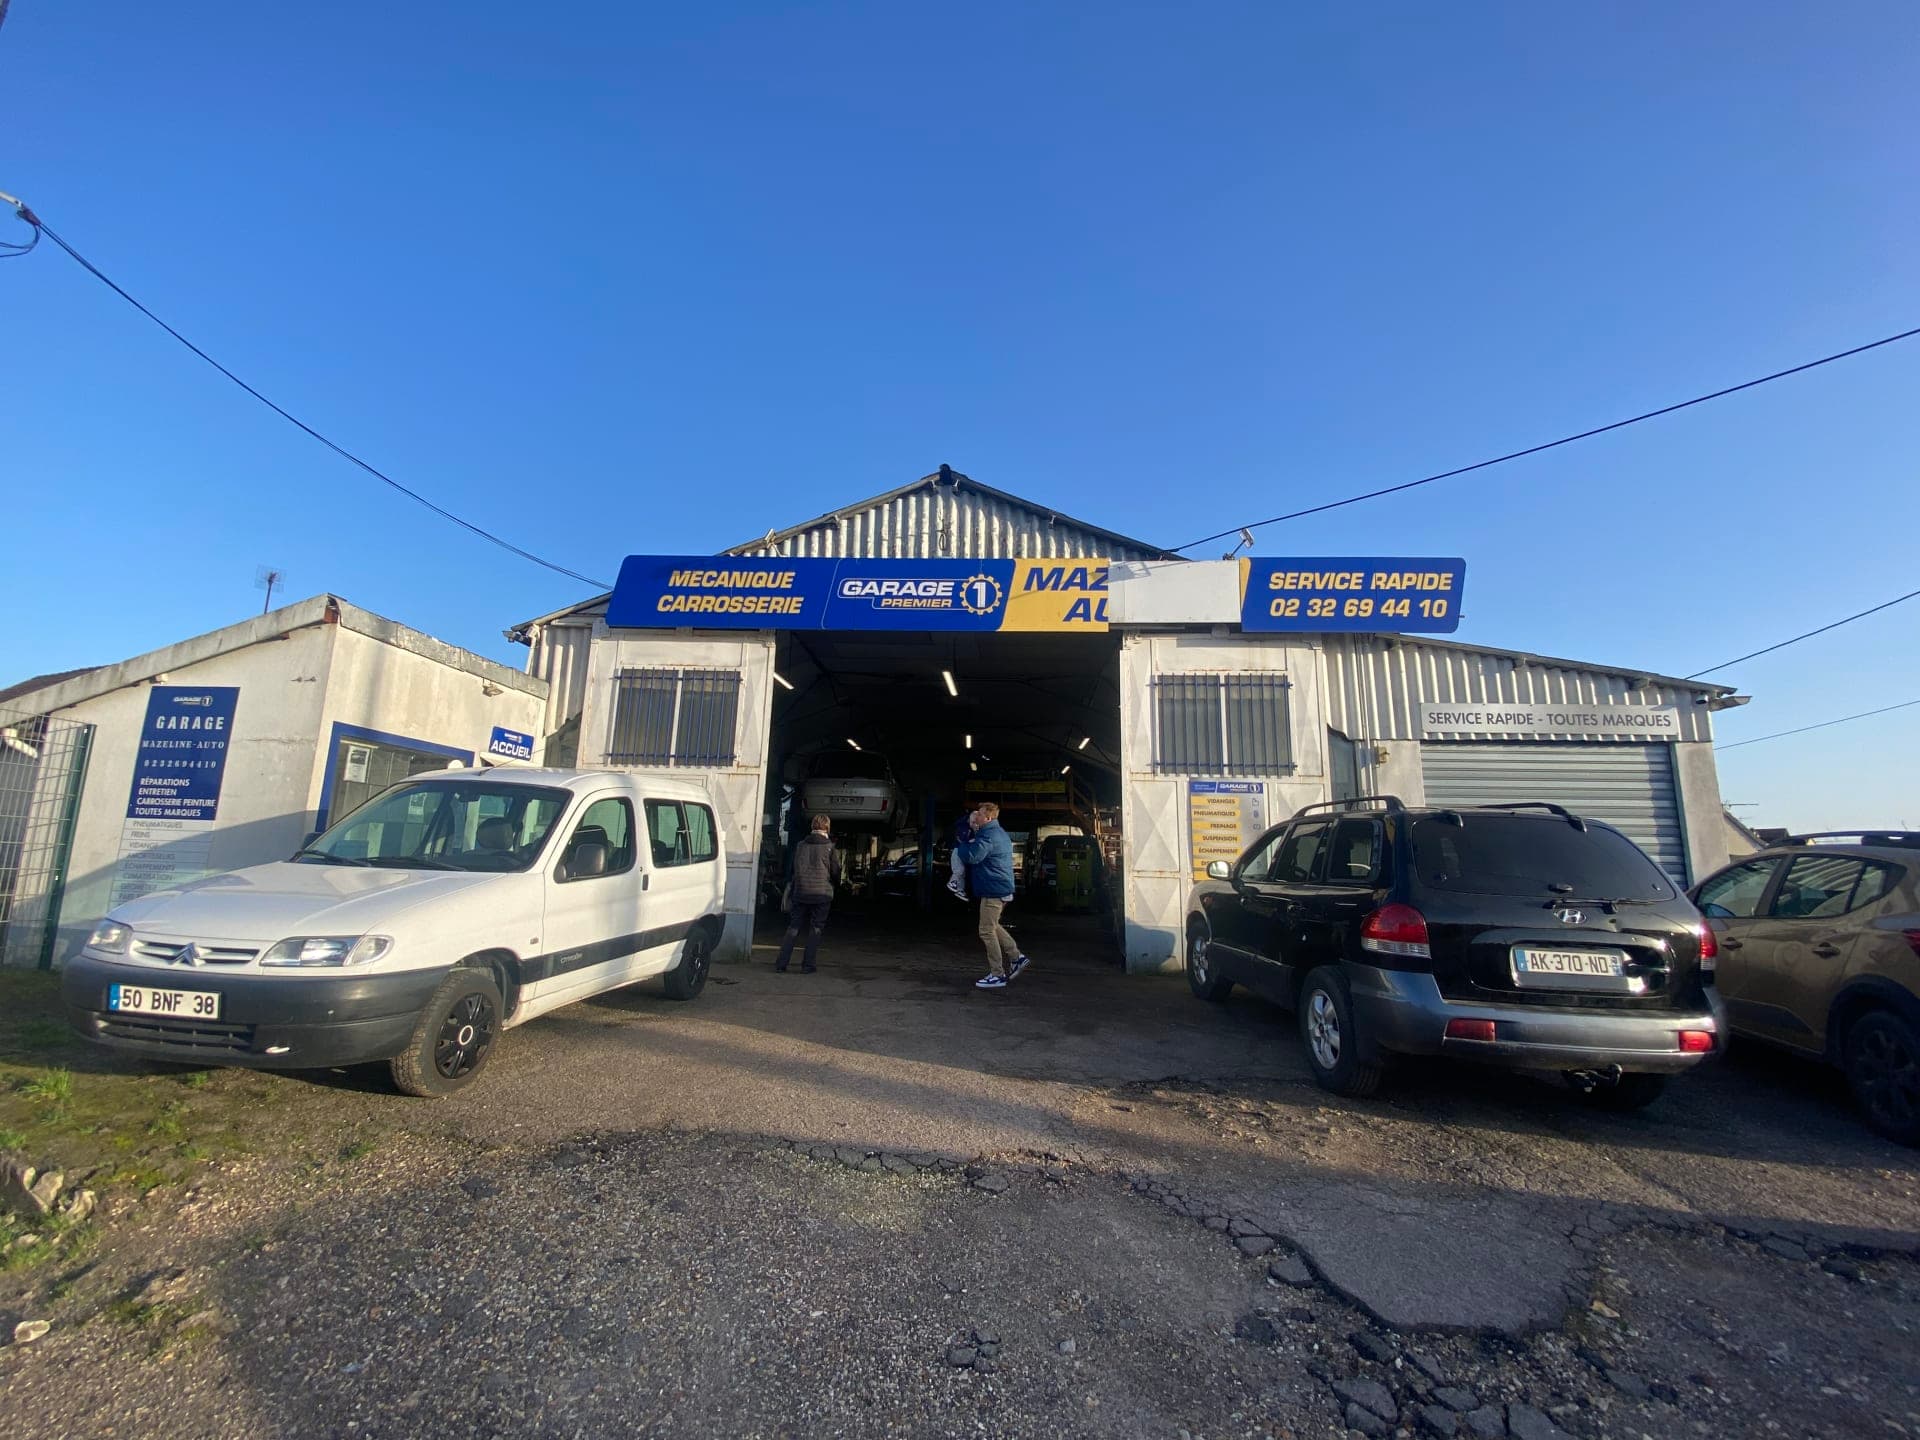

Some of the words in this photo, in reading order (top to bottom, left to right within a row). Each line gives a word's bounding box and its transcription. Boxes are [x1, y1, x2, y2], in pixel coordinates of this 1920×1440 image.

[668, 570, 796, 589] MECANIQUE
[1023, 566, 1108, 591] MAZ
[1269, 572, 1365, 590] SERVICE
[1370, 573, 1454, 591] RAPIDE
[842, 580, 955, 596] GARAGE
[972, 581, 987, 609] 1
[881, 598, 953, 608] PREMIER
[656, 594, 805, 614] CARROSSERIE
[1270, 598, 1301, 617] 02
[1306, 598, 1337, 617] 32
[1343, 598, 1374, 618] 69
[1380, 599, 1411, 618] 44
[1419, 599, 1448, 618] 10
[156, 715, 225, 730] GARAGE
[1428, 712, 1482, 725] SERVICE
[1486, 712, 1534, 726] RAPIDE
[1549, 713, 1599, 726] TOUTES
[1602, 713, 1672, 728] MARQUES
[141, 740, 225, 750] MAZELINE-AUTO
[490, 739, 532, 759] ACCUEIL
[140, 776, 191, 787] RÉPARATIONS
[138, 787, 178, 796] ENTRETIEN
[136, 797, 182, 806] CARROSSERIE
[183, 799, 217, 807] PEINTURE
[134, 807, 163, 816] TOUTES
[163, 808, 202, 817] MARQUES
[122, 988, 143, 1009] 50
[151, 991, 184, 1012] BNF
[193, 994, 215, 1015] 38
